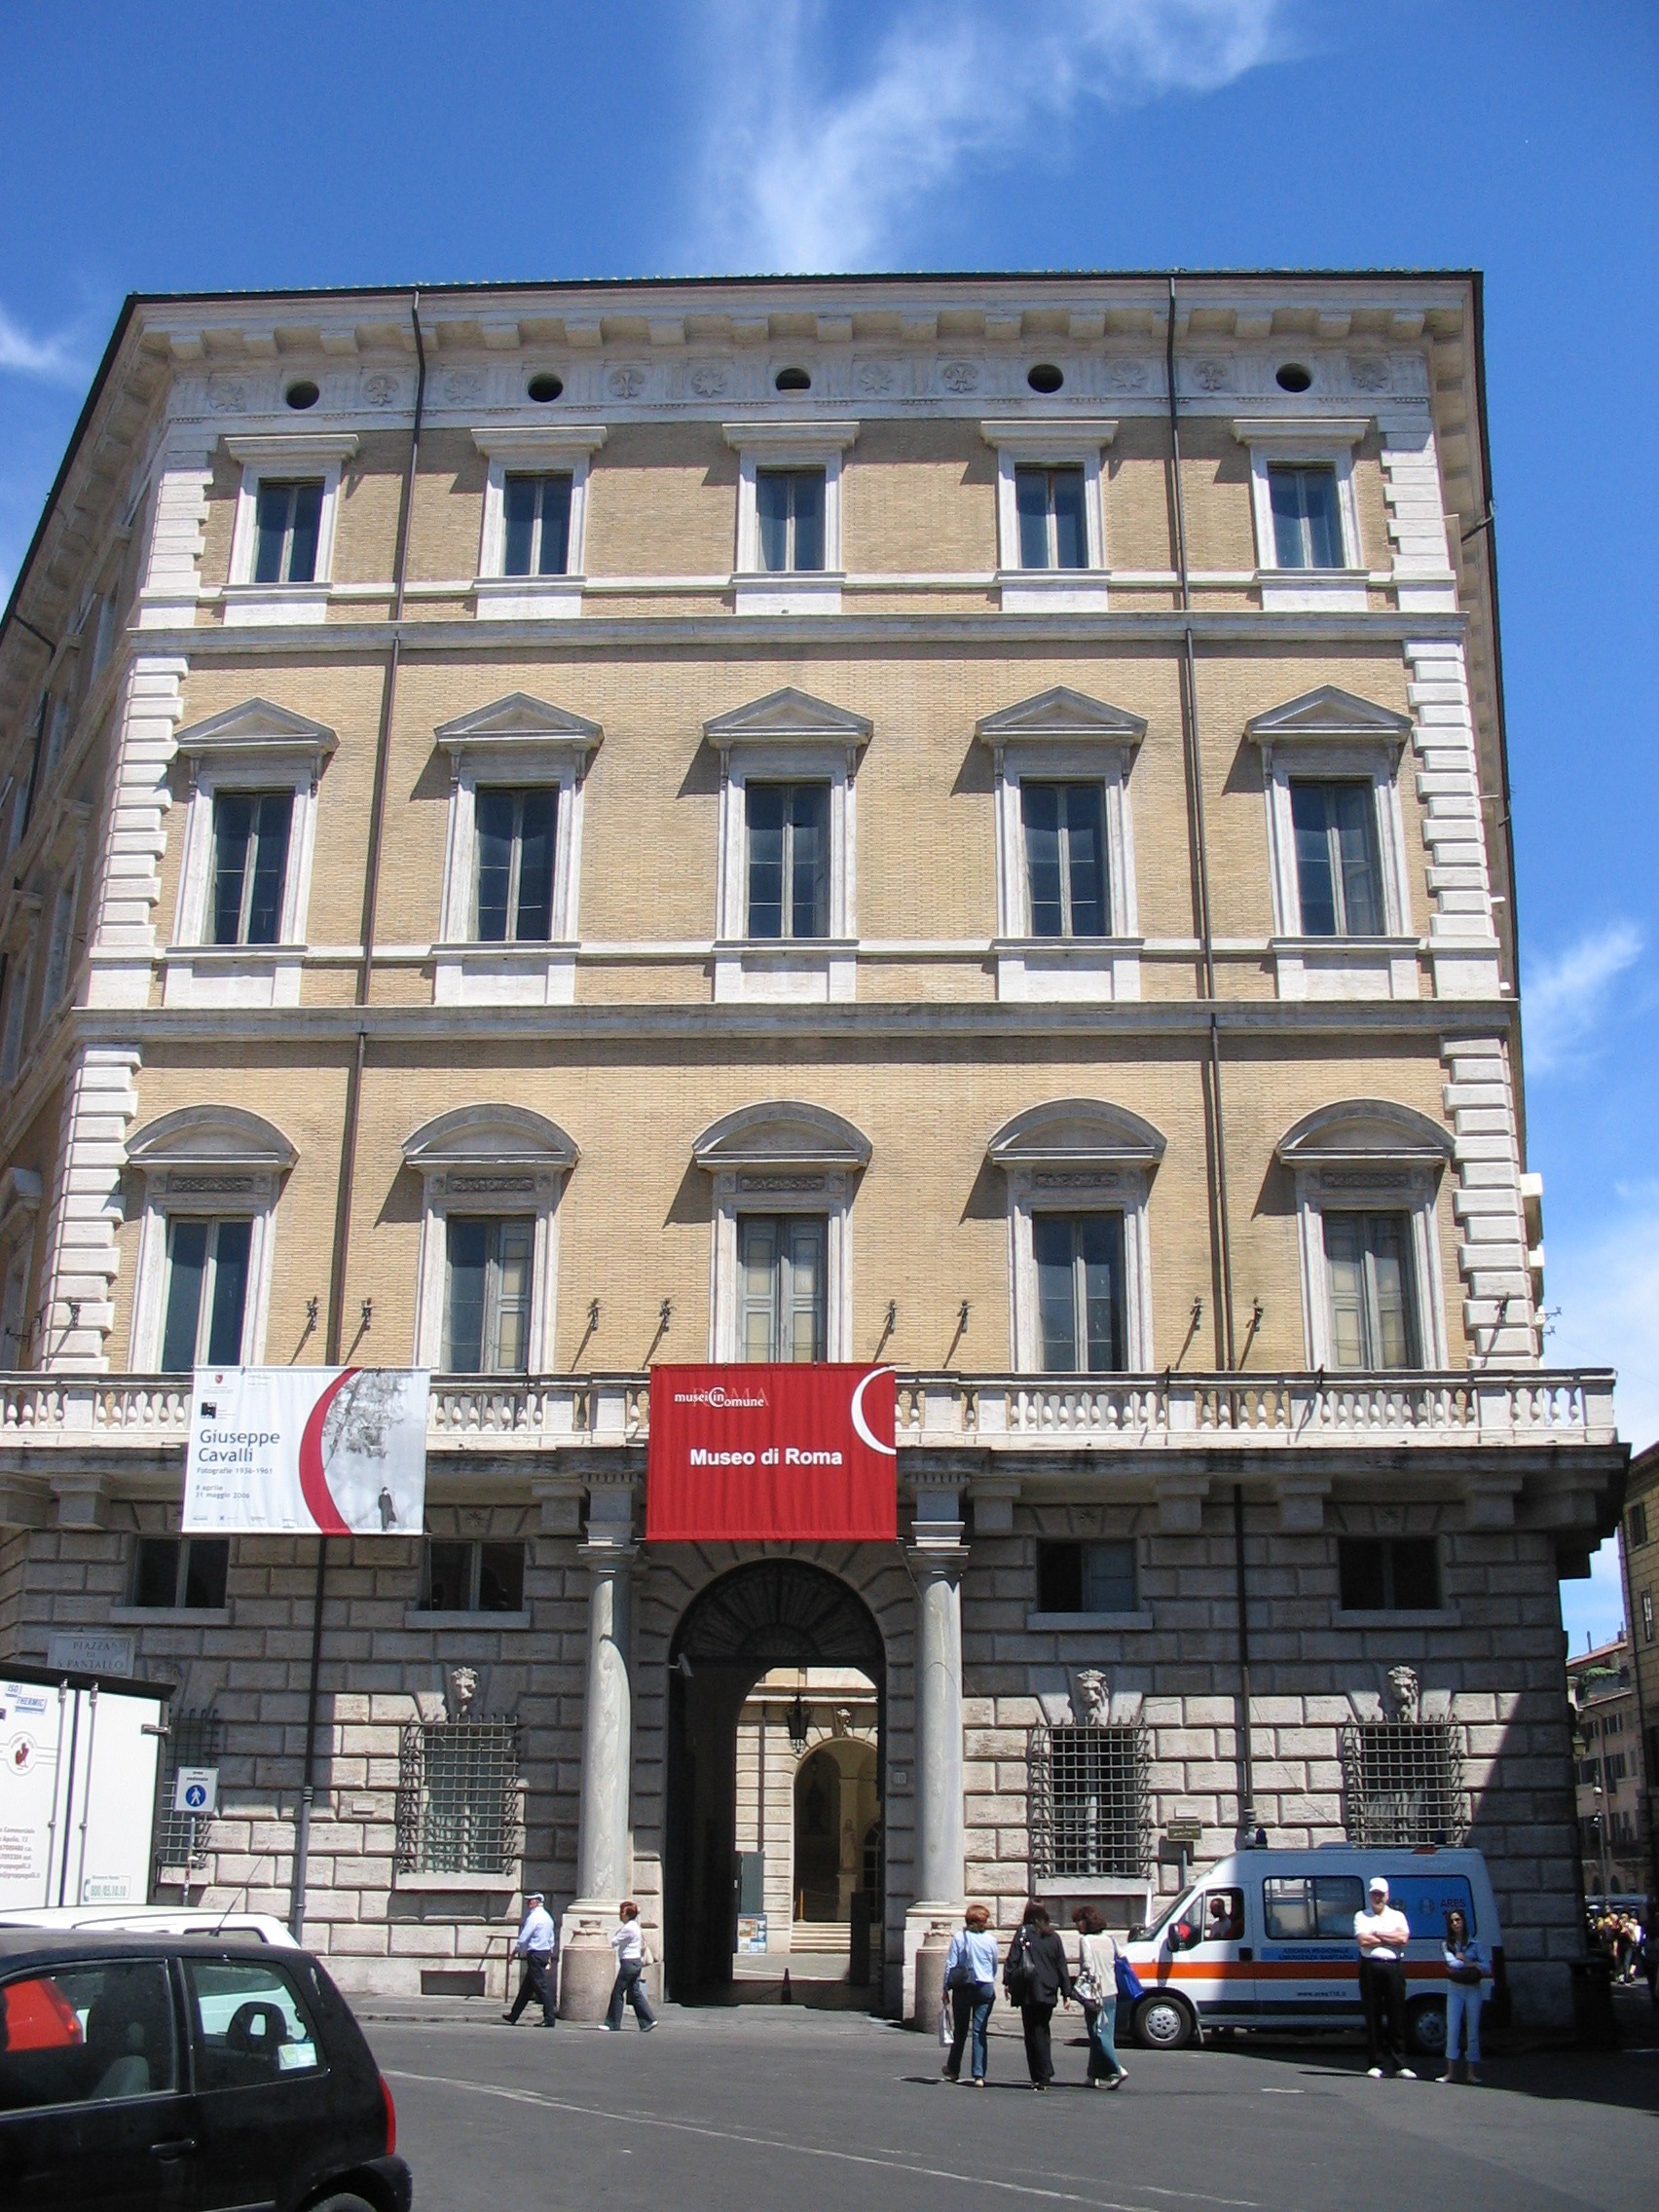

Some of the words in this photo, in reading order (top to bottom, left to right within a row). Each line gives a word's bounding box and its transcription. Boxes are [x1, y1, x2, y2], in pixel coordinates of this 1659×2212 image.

[200, 1429, 280, 1447] Giuseppe
[198, 1448, 253, 1461] Cavalli
[689, 1449, 756, 1465] Museo
[760, 1448, 779, 1465] di
[785, 1448, 843, 1465] Roma
[73, 1641, 110, 1650] PIAZZA
[1440, 1899, 1466, 1908] ARES
